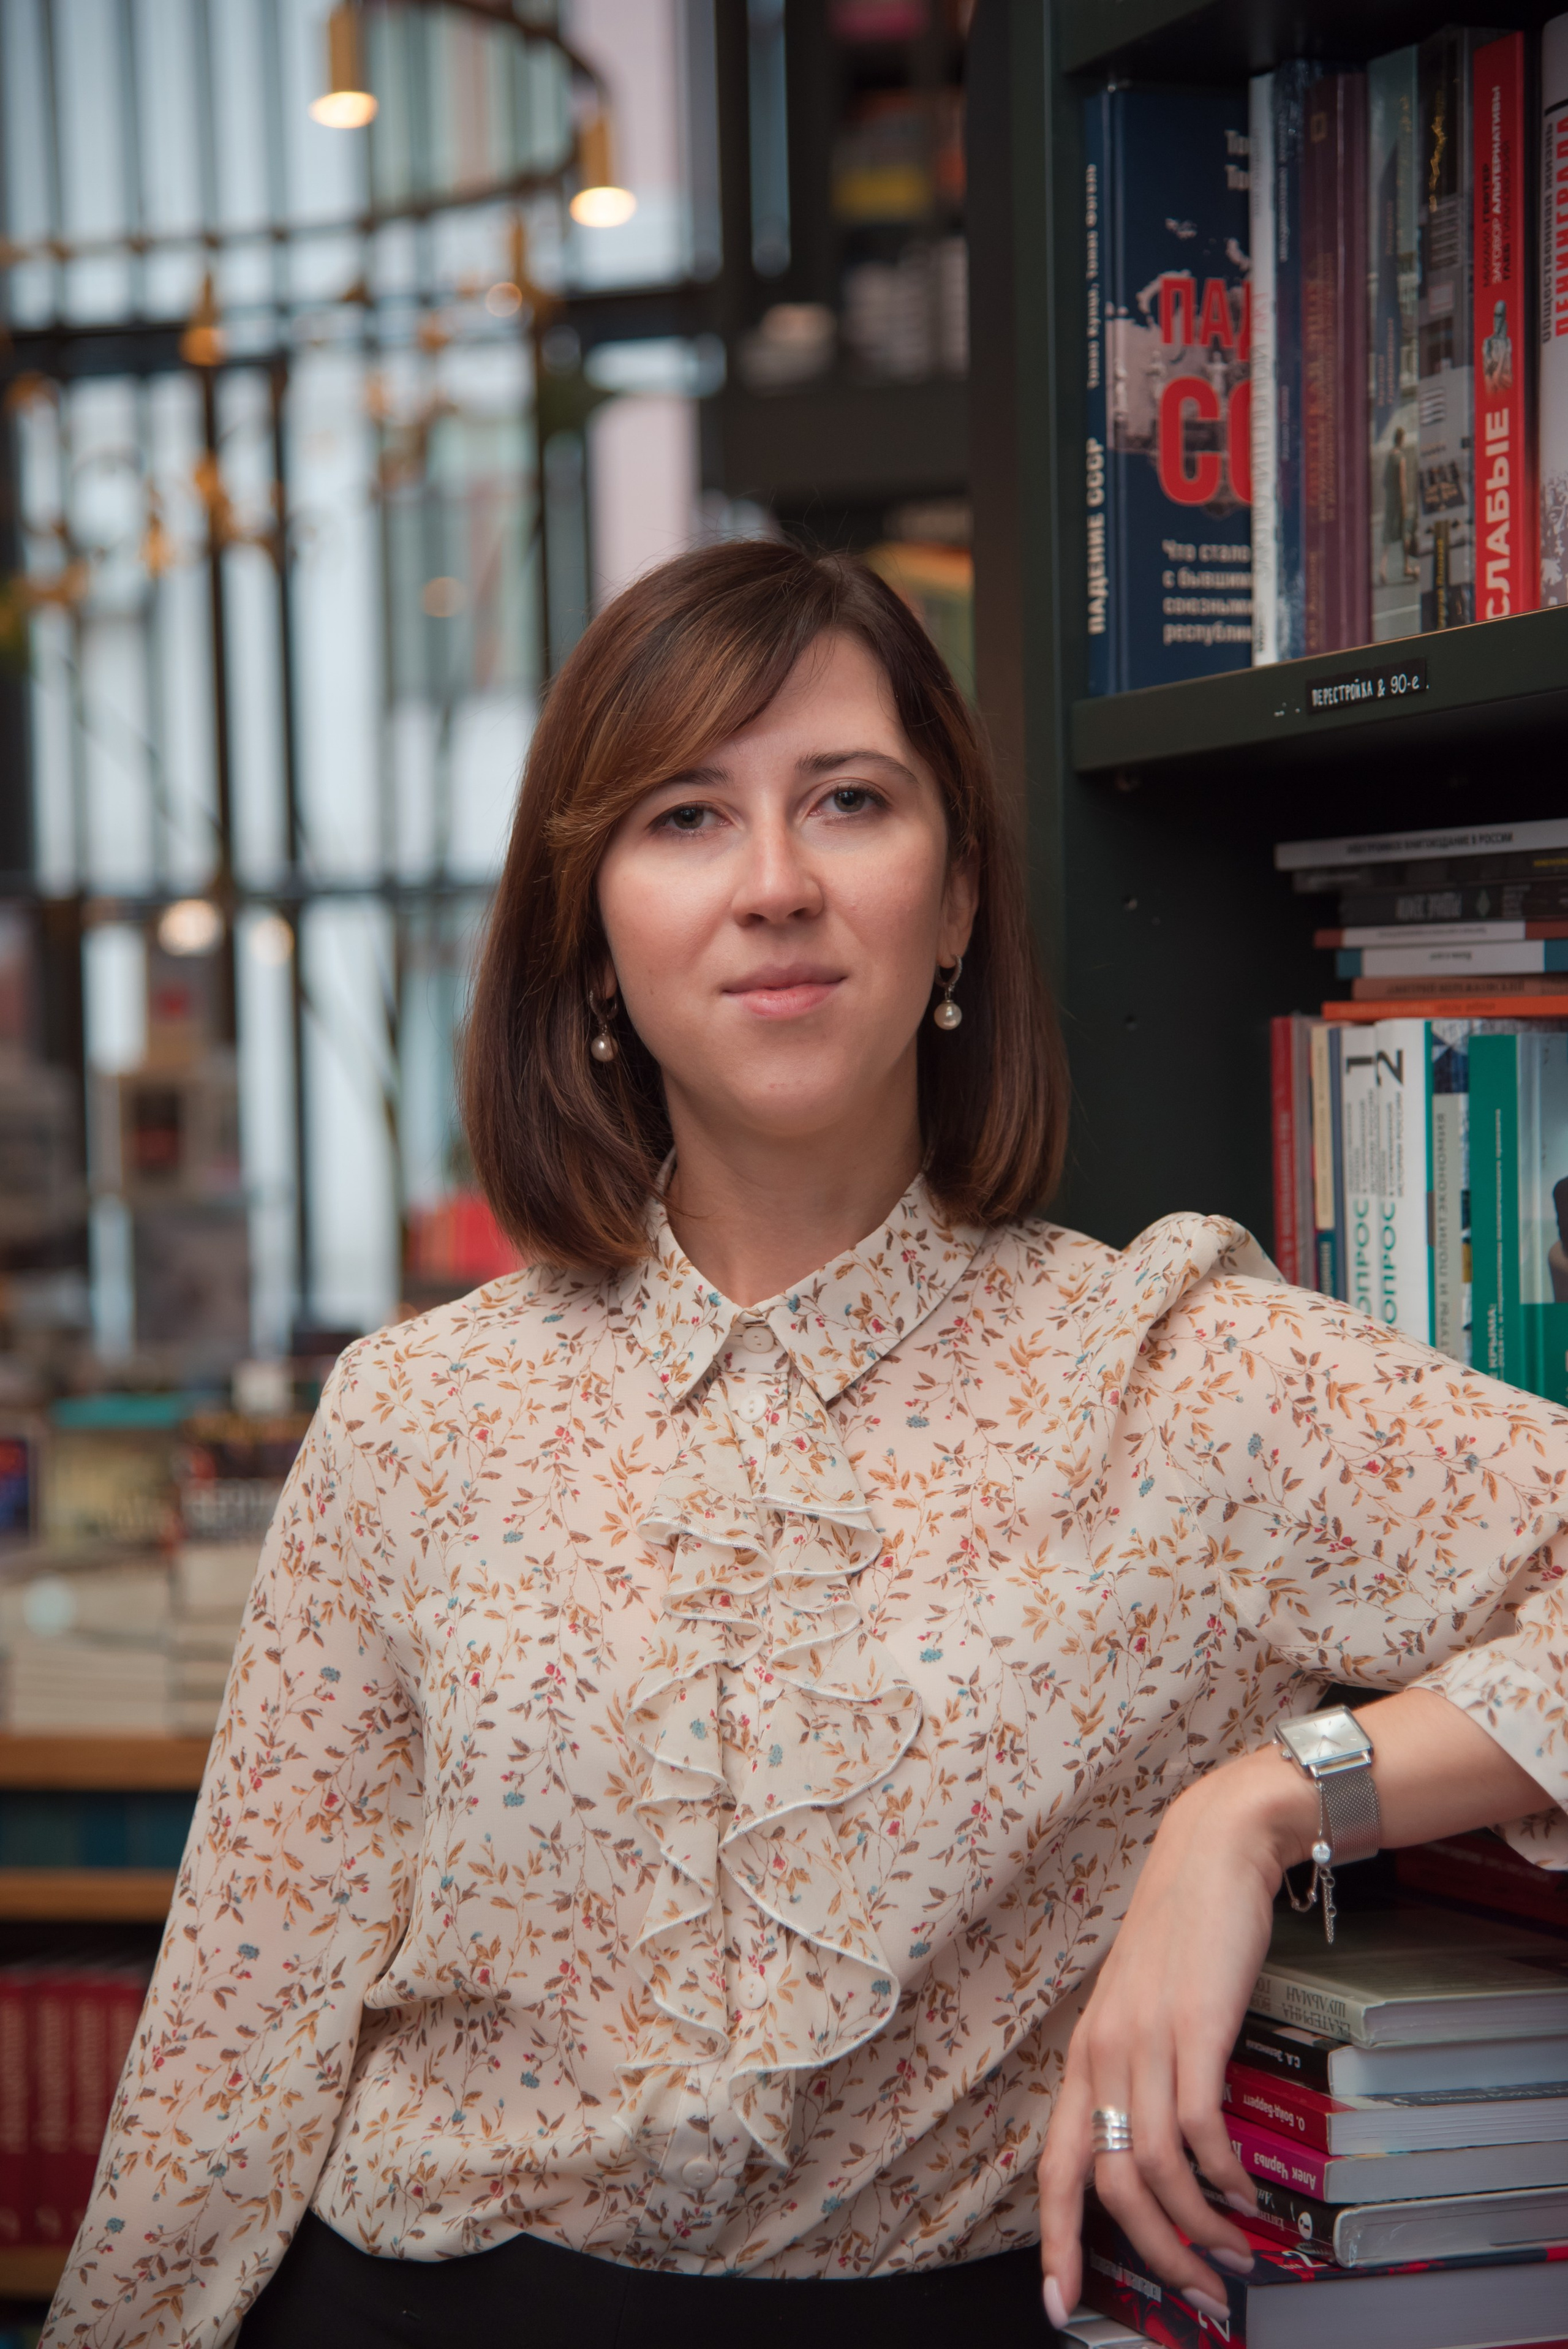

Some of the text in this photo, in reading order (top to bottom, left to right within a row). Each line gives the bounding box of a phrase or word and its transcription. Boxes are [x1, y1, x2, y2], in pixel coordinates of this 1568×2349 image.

[1084, 163, 1098, 228] Фогель
[1491, 85, 1503, 284] ЗАГОВОР АЛЬТЕРНАТИВЫ
[1085, 230, 1099, 281] Томас
[1502, 243, 1511, 281] ГЛЕБ
[1086, 339, 1101, 390] Томас
[1486, 407, 1511, 620] СЛАБЫЕ
[1086, 437, 1108, 636] ПАДЕНИЕ СССР
[1161, 538, 1251, 564] Что стало
[1161, 569, 1175, 590] с
[1311, 673, 1420, 707] ПЕРЕСТРОЙКА & 90-е
[1346, 1055, 1374, 1074] 1
[1376, 1049, 1404, 1087] 2
[1438, 1283, 1449, 1295] И
[1281, 2002, 1351, 2038] ЕКАТЕРИНА
[1286, 1985, 1346, 2018] ШУЛЬМАН
[1296, 2115, 1305, 2132] О.
[1253, 2152, 1316, 2191] Алек Чарльз
